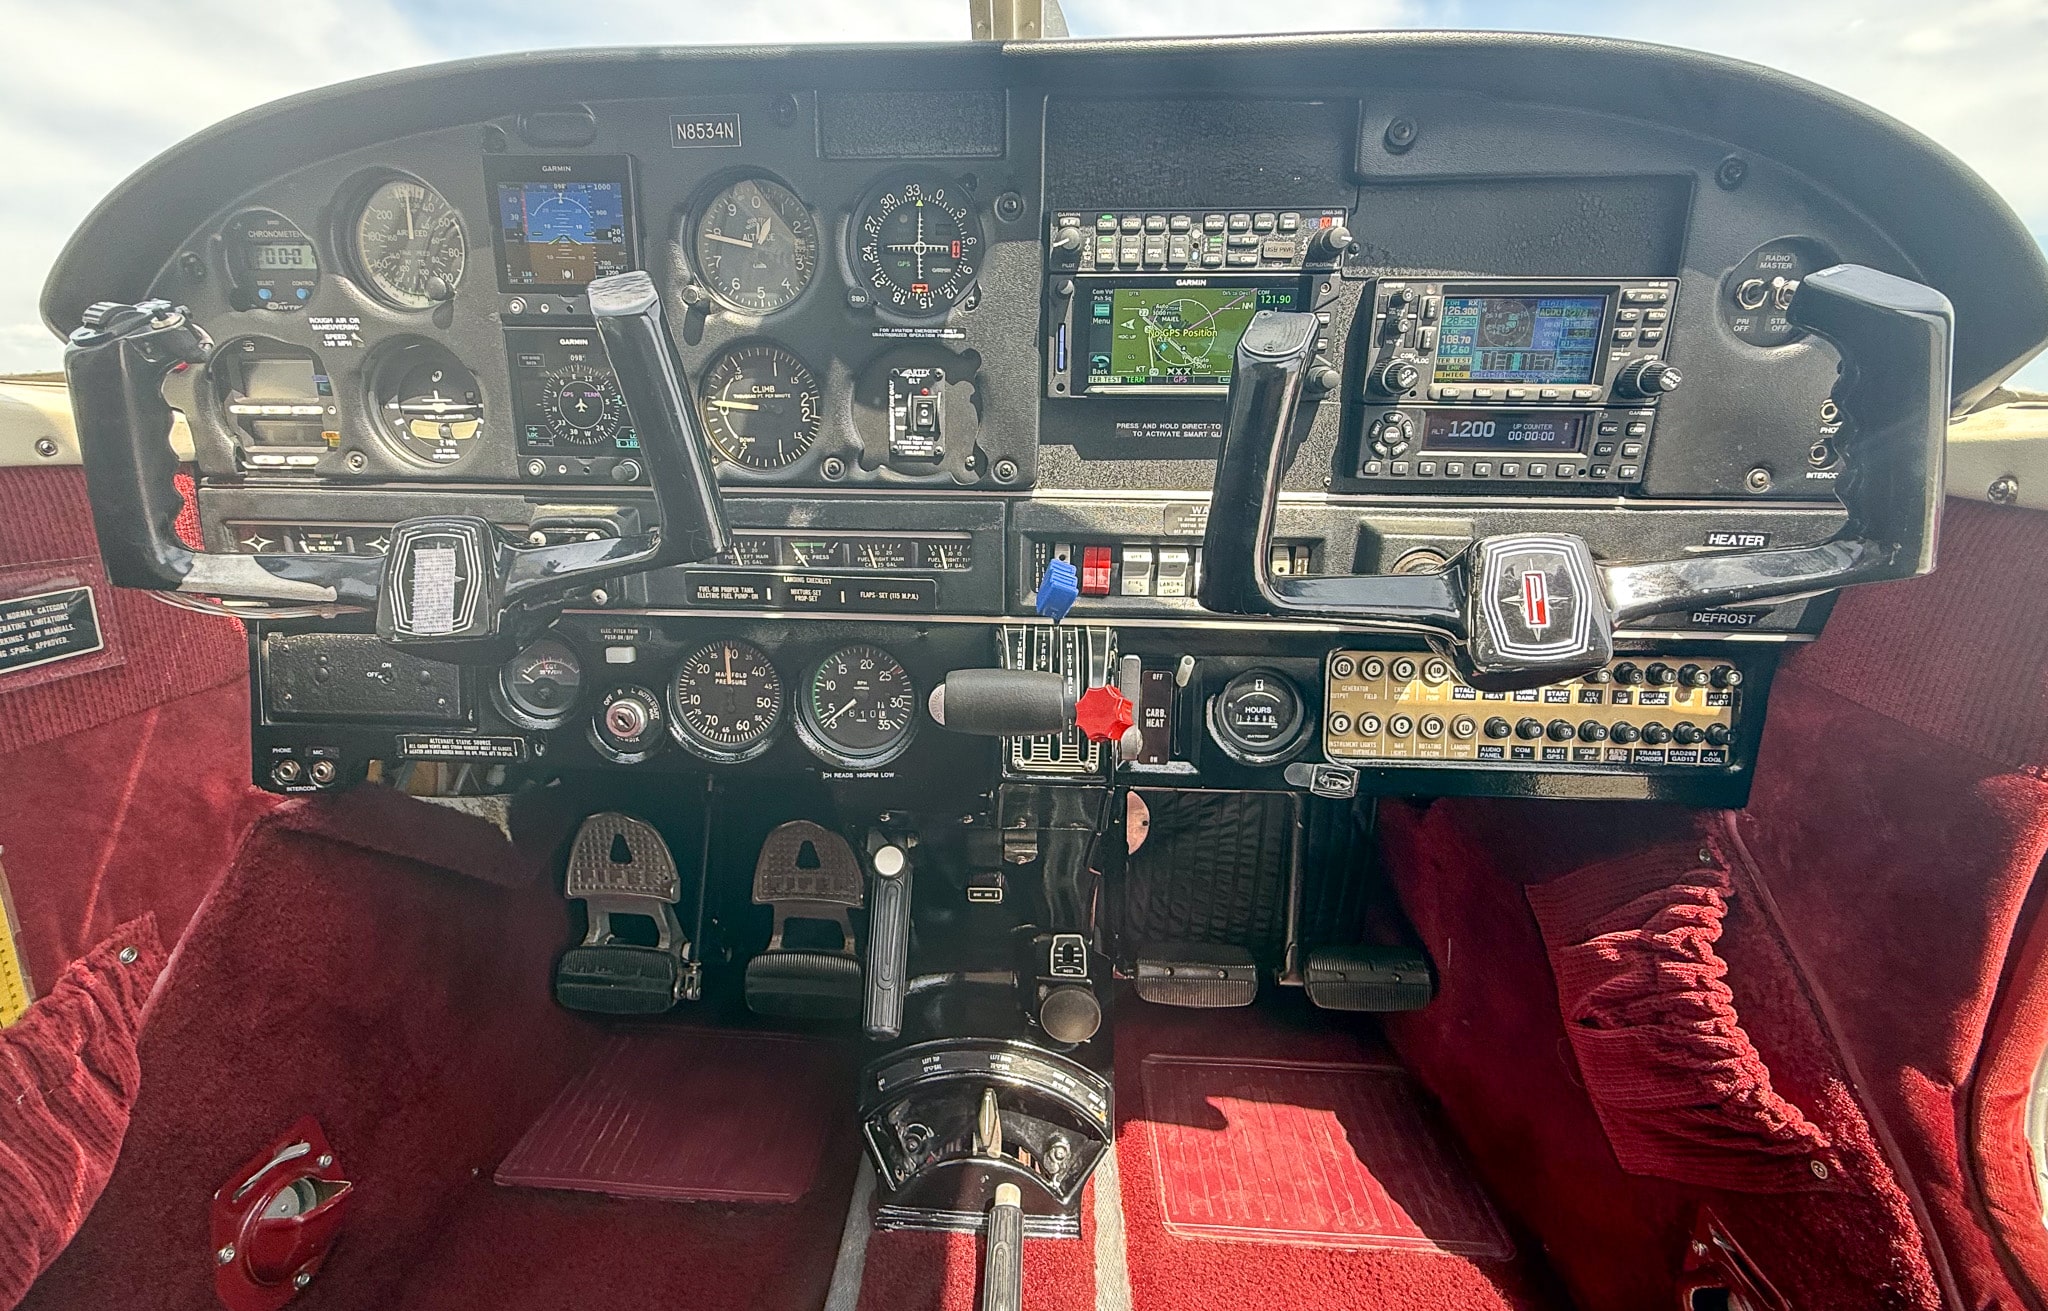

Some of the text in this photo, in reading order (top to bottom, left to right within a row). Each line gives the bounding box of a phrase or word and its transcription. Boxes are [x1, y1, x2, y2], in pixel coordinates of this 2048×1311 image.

[676, 122, 734, 140] N8534N
[905, 184, 921, 197] 33
[752, 196, 761, 208] 0
[880, 194, 896, 209] 30
[422, 203, 435, 213] 40
[728, 204, 737, 216] 9
[376, 210, 393, 220] 200
[793, 221, 801, 234] 2
[865, 216, 878, 233] 27
[448, 248, 460, 258] 80
[863, 246, 872, 262] 24
[713, 256, 722, 268] 7
[732, 278, 741, 290] 6
[781, 278, 790, 289] 4
[871, 273, 886, 288] 21
[757, 287, 765, 298] 5
[944, 285, 959, 300] 12
[892, 293, 906, 306] 18
[919, 298, 934, 310] 15
[1260, 295, 1291, 304] 121.90
[1444, 307, 1478, 315] 126.300
[1442, 317, 1477, 325] 128.250
[1149, 329, 1218, 337] No GPS Position
[1441, 335, 1471, 344] 108.70
[1440, 345, 1470, 354] 112.60
[800, 392, 810, 407] 2
[801, 408, 811, 422] 2
[1448, 421, 1496, 438] 1200
[1508, 431, 1555, 441] 00:00:00
[1709, 534, 1765, 546] HEATER
[790, 588, 822, 596] MIXTURE-SET
[1526, 575, 1542, 624] P
[6, 602, 69, 621] NORMAL CATEGORY
[29, 613, 70, 627] LIMITATIONS
[1692, 613, 1756, 625] DEFROST
[27, 623, 76, 640] AND MANUALS.
[9, 637, 71, 655] SPINS. APPROVED.
[697, 664, 711, 674] 20
[838, 664, 848, 675] 15
[860, 660, 873, 670] 20
[751, 666, 766, 677] 40
[879, 671, 892, 681] 25
[826, 680, 836, 691] 10
[603, 694, 613, 706] OFF
[638, 690, 651, 703] BOTH
[690, 694, 701, 705] 10
[756, 697, 771, 708] 50
[889, 697, 904, 709] 30
[649, 700, 660, 720] START
[1145, 708, 1167, 718] CARB.
[1245, 706, 1272, 714] HOURS
[705, 715, 719, 726] 70
[736, 720, 750, 731] 60
[877, 720, 891, 731] 35
[1145, 718, 1164, 728] HEAT
